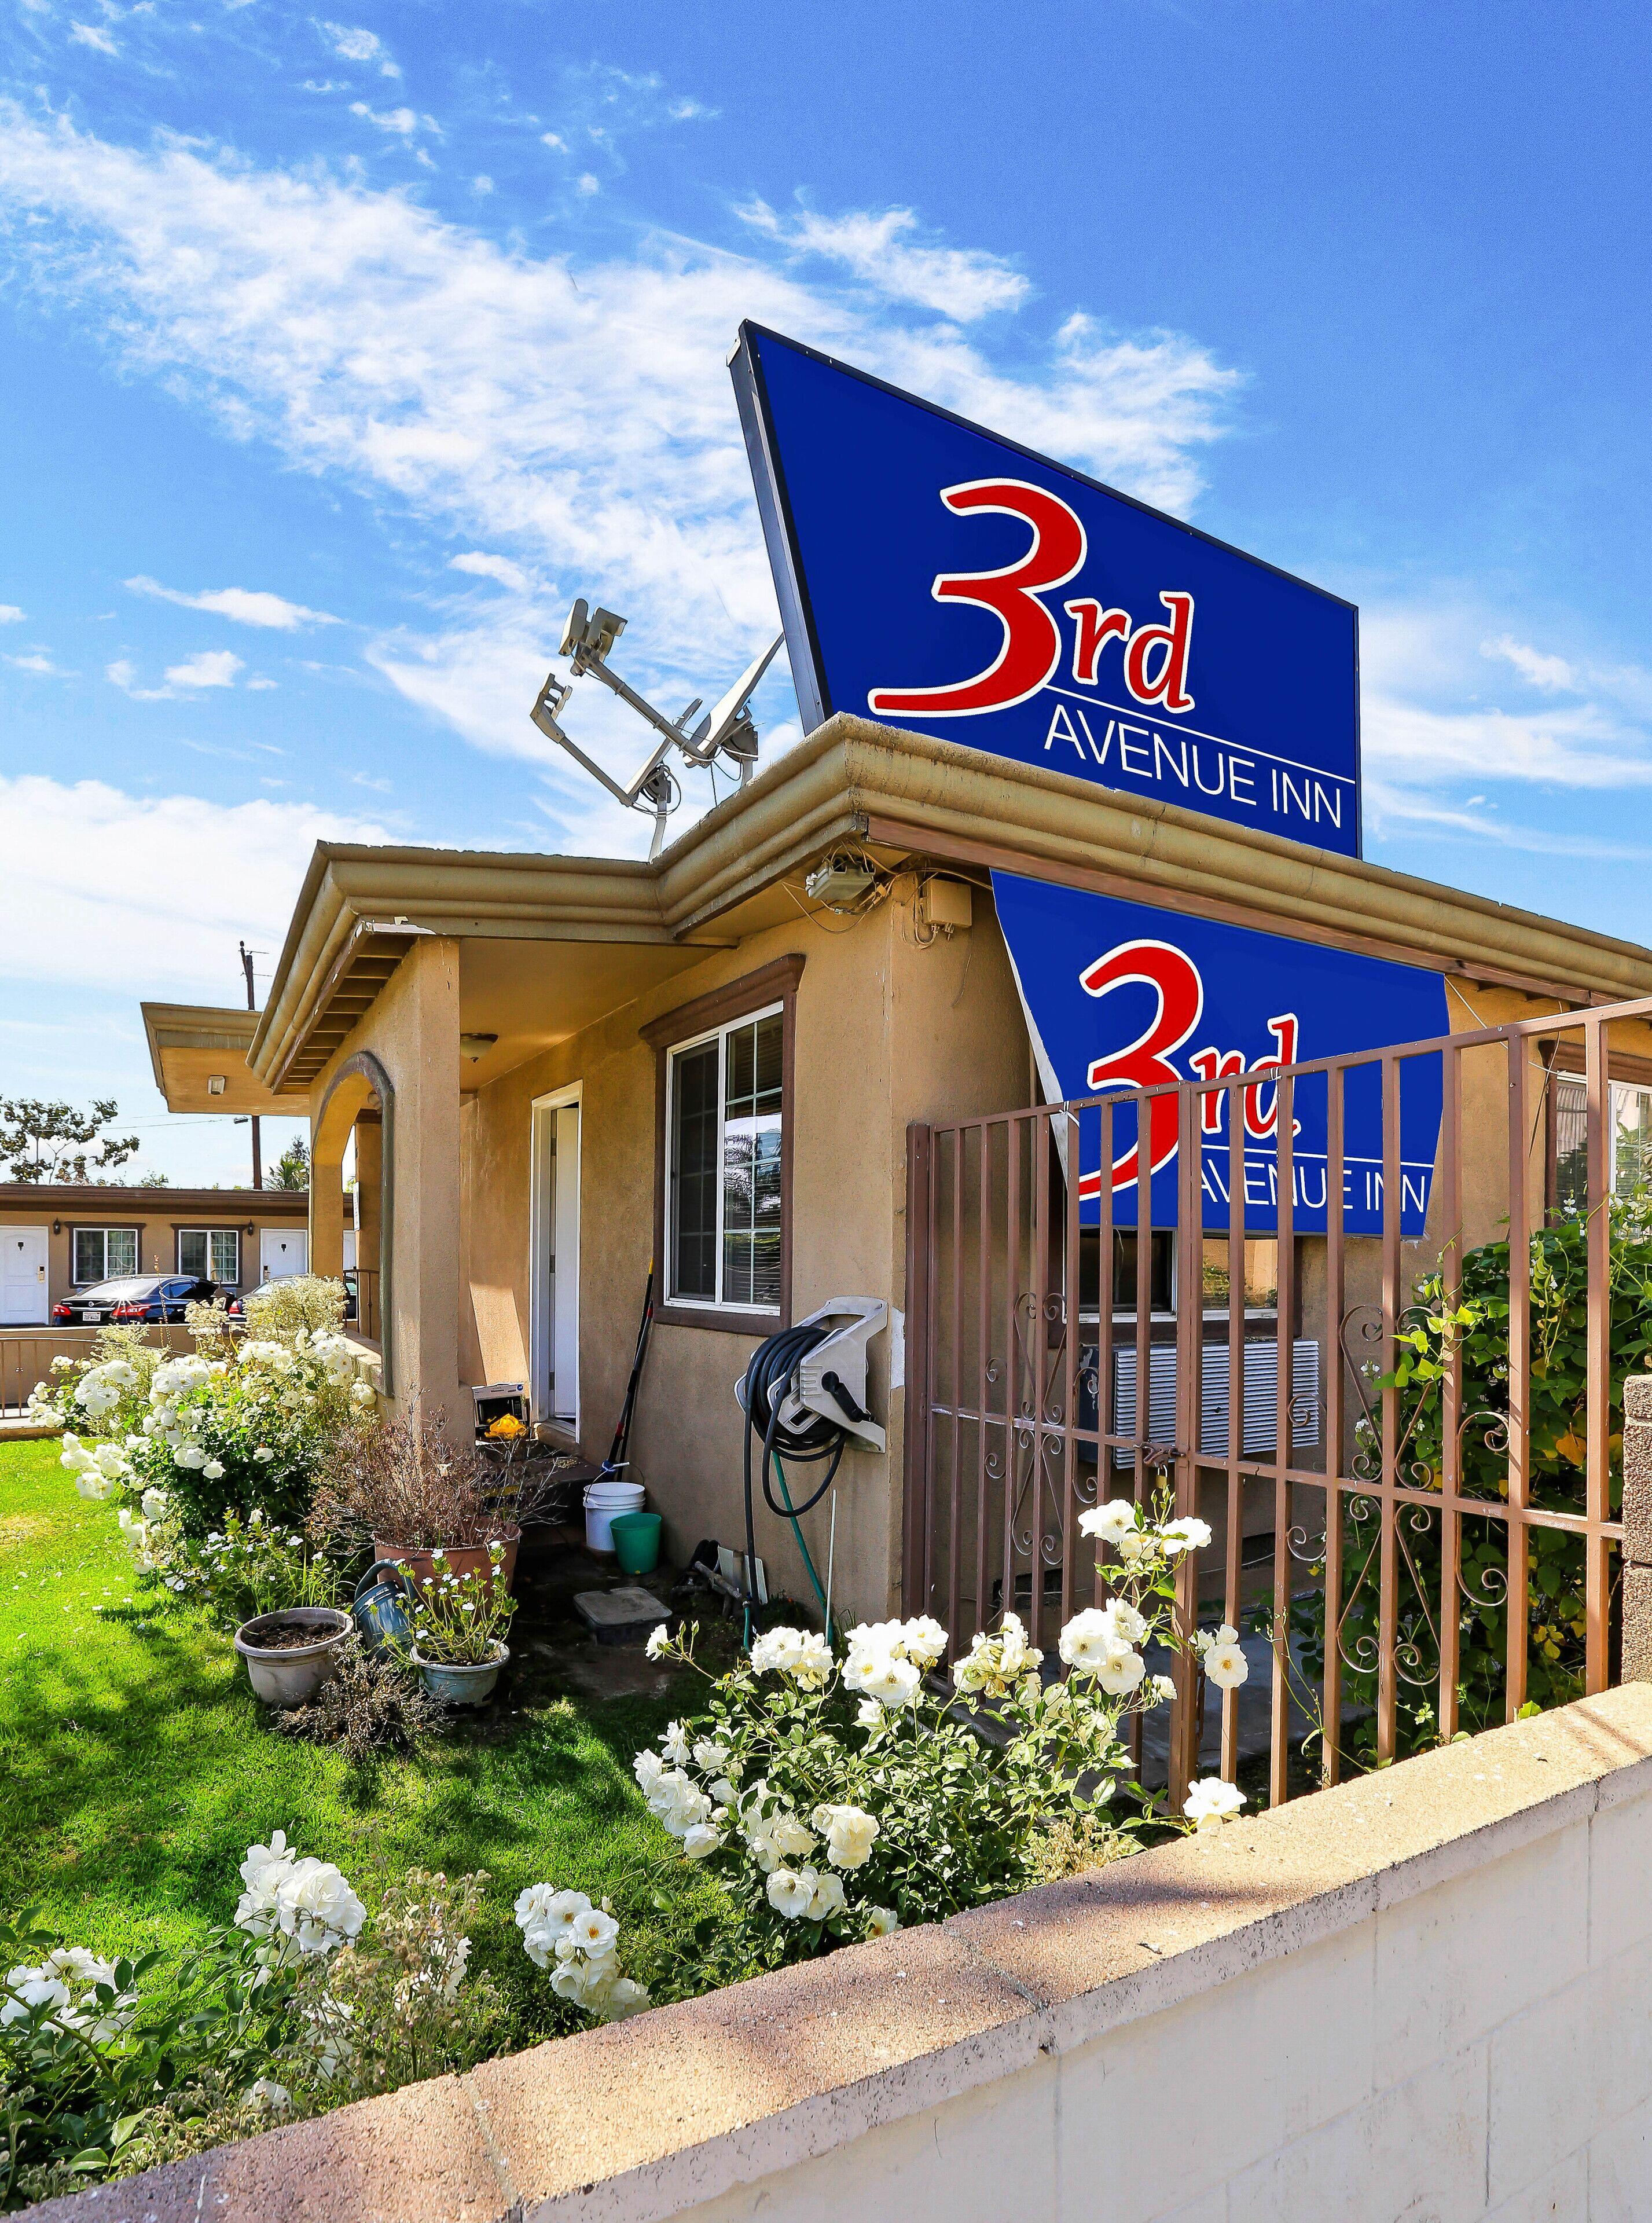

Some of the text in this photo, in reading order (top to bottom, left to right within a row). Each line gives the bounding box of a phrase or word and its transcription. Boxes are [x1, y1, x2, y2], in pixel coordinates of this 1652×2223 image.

[868, 478, 1195, 717] 3rd
[1044, 704, 1341, 828] AVENUE INN
[1079, 939, 1301, 1201] 3rd
